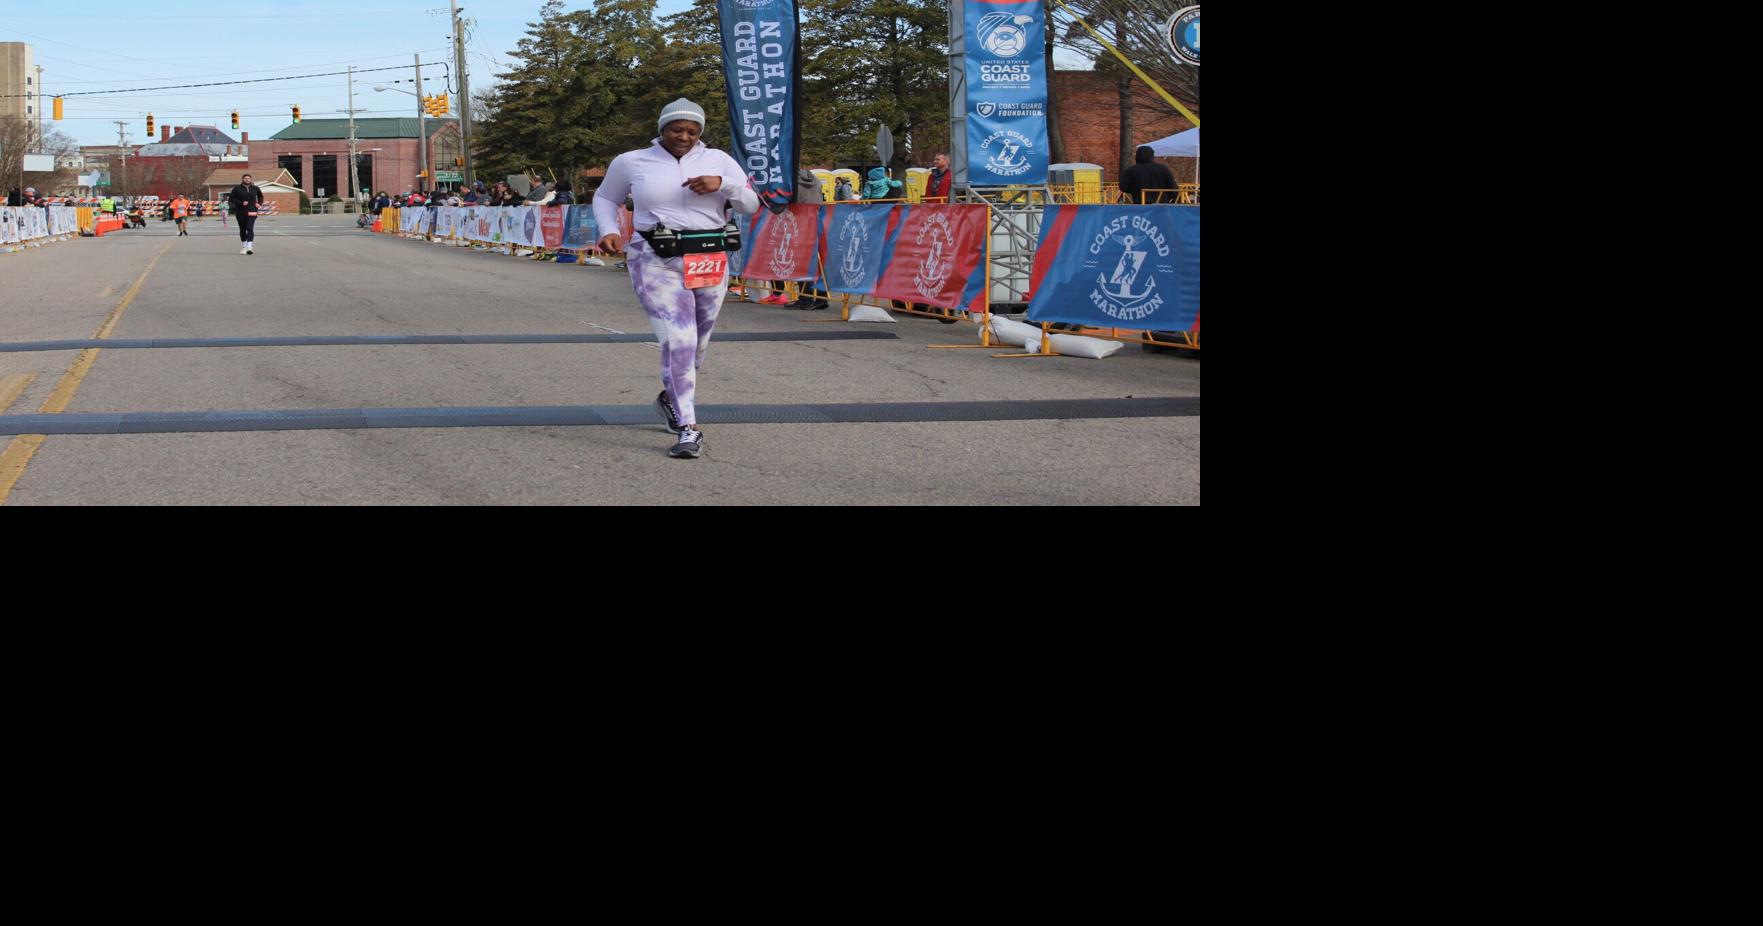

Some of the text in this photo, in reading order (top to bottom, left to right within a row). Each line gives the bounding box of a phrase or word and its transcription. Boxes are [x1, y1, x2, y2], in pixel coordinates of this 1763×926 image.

[734, 21, 761, 100] GUARD
[980, 65, 1030, 73] COAST
[981, 74, 1031, 82] GUARD
[759, 20, 787, 184] MARATHON
[742, 110, 769, 185] COAST
[981, 130, 1033, 149] COAST GUARD
[984, 162, 1032, 176] MARATHON
[916, 212, 953, 246] COAST GUARD
[1089, 215, 1170, 257] COAST GUARD
[687, 260, 722, 275] 2221
[1089, 289, 1164, 320] MARATHON
